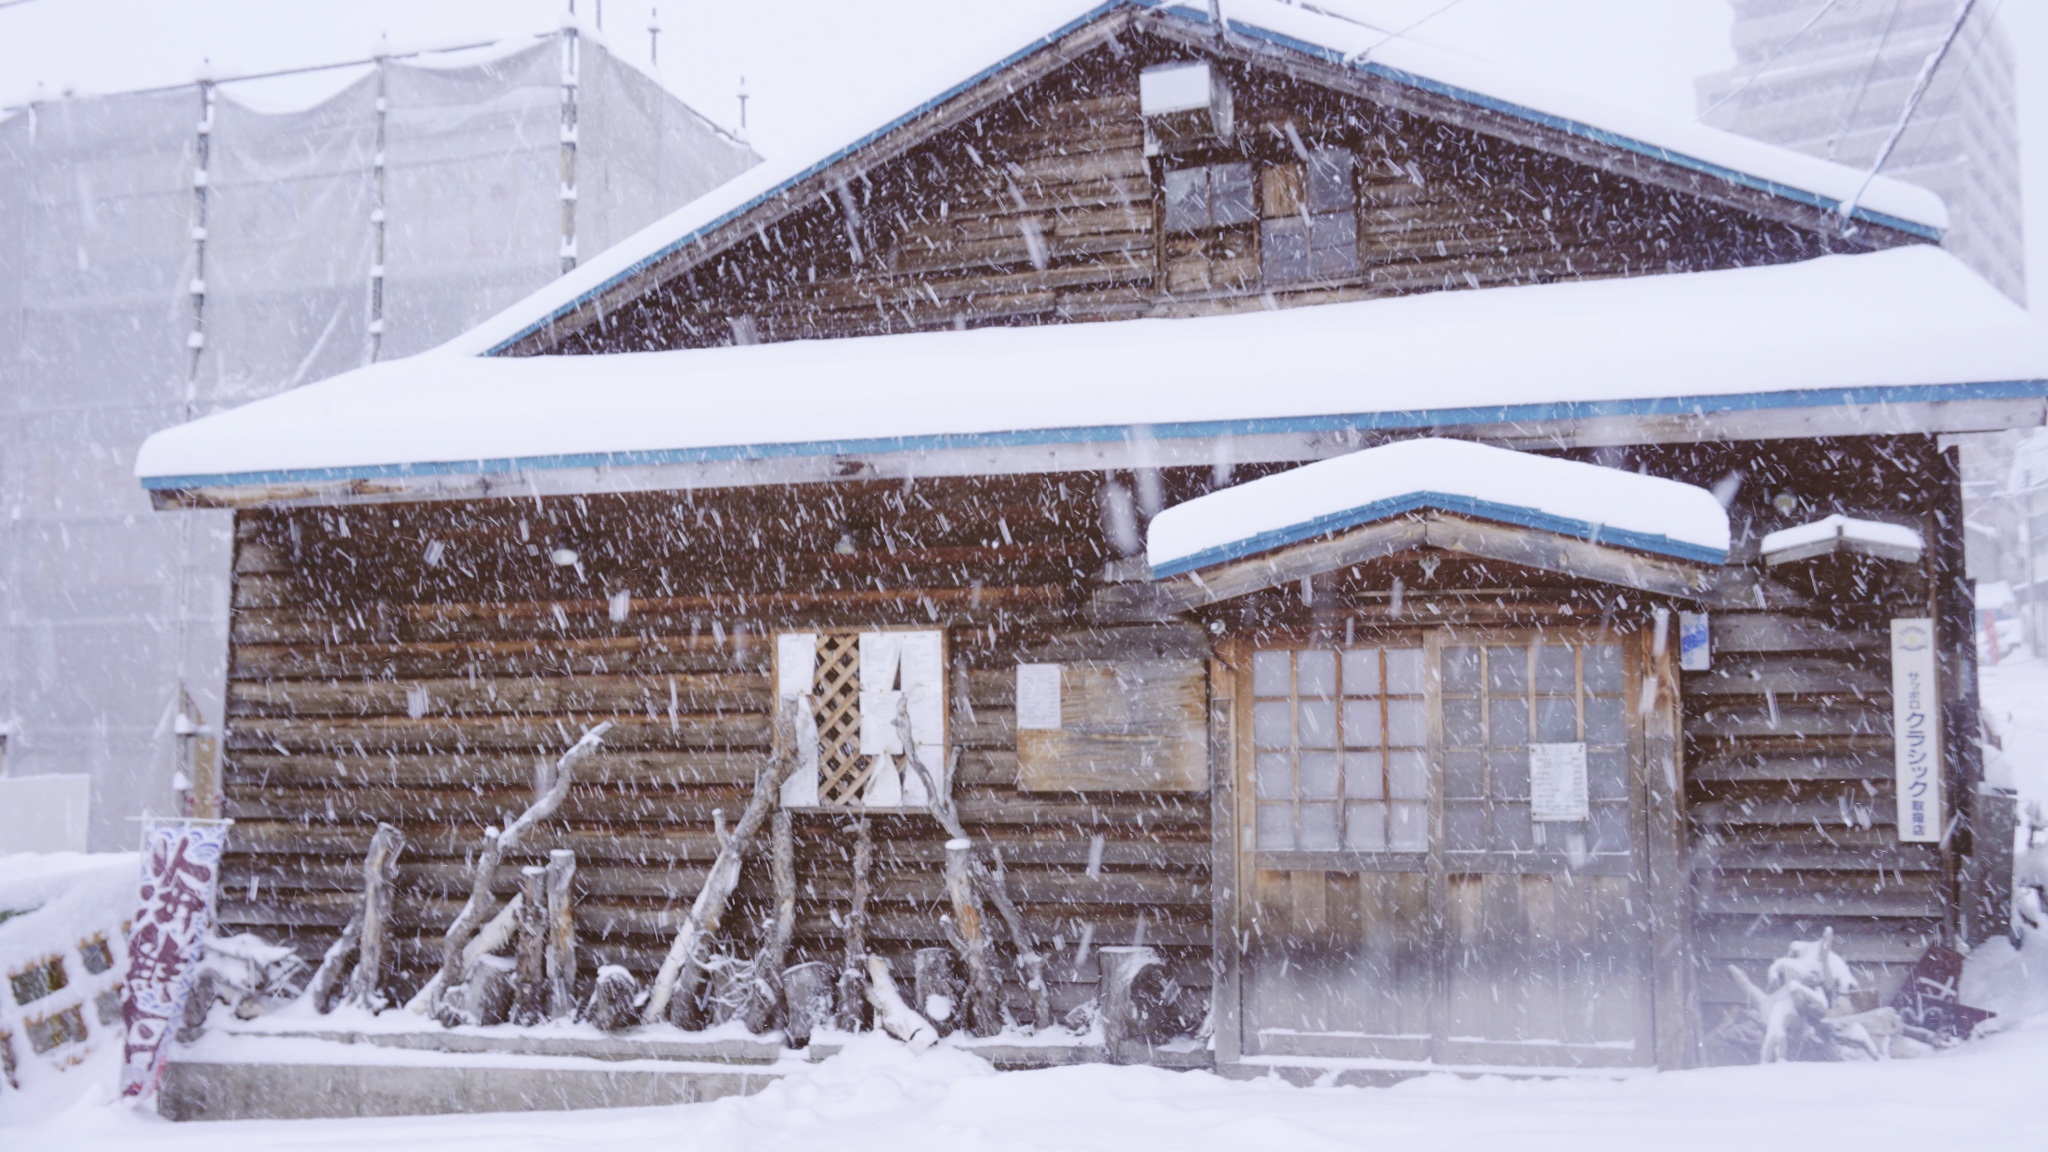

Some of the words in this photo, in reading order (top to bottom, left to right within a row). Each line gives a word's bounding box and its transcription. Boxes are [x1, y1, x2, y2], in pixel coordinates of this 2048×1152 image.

[1906, 671, 1928, 836] サッポロクラシック取扱店
